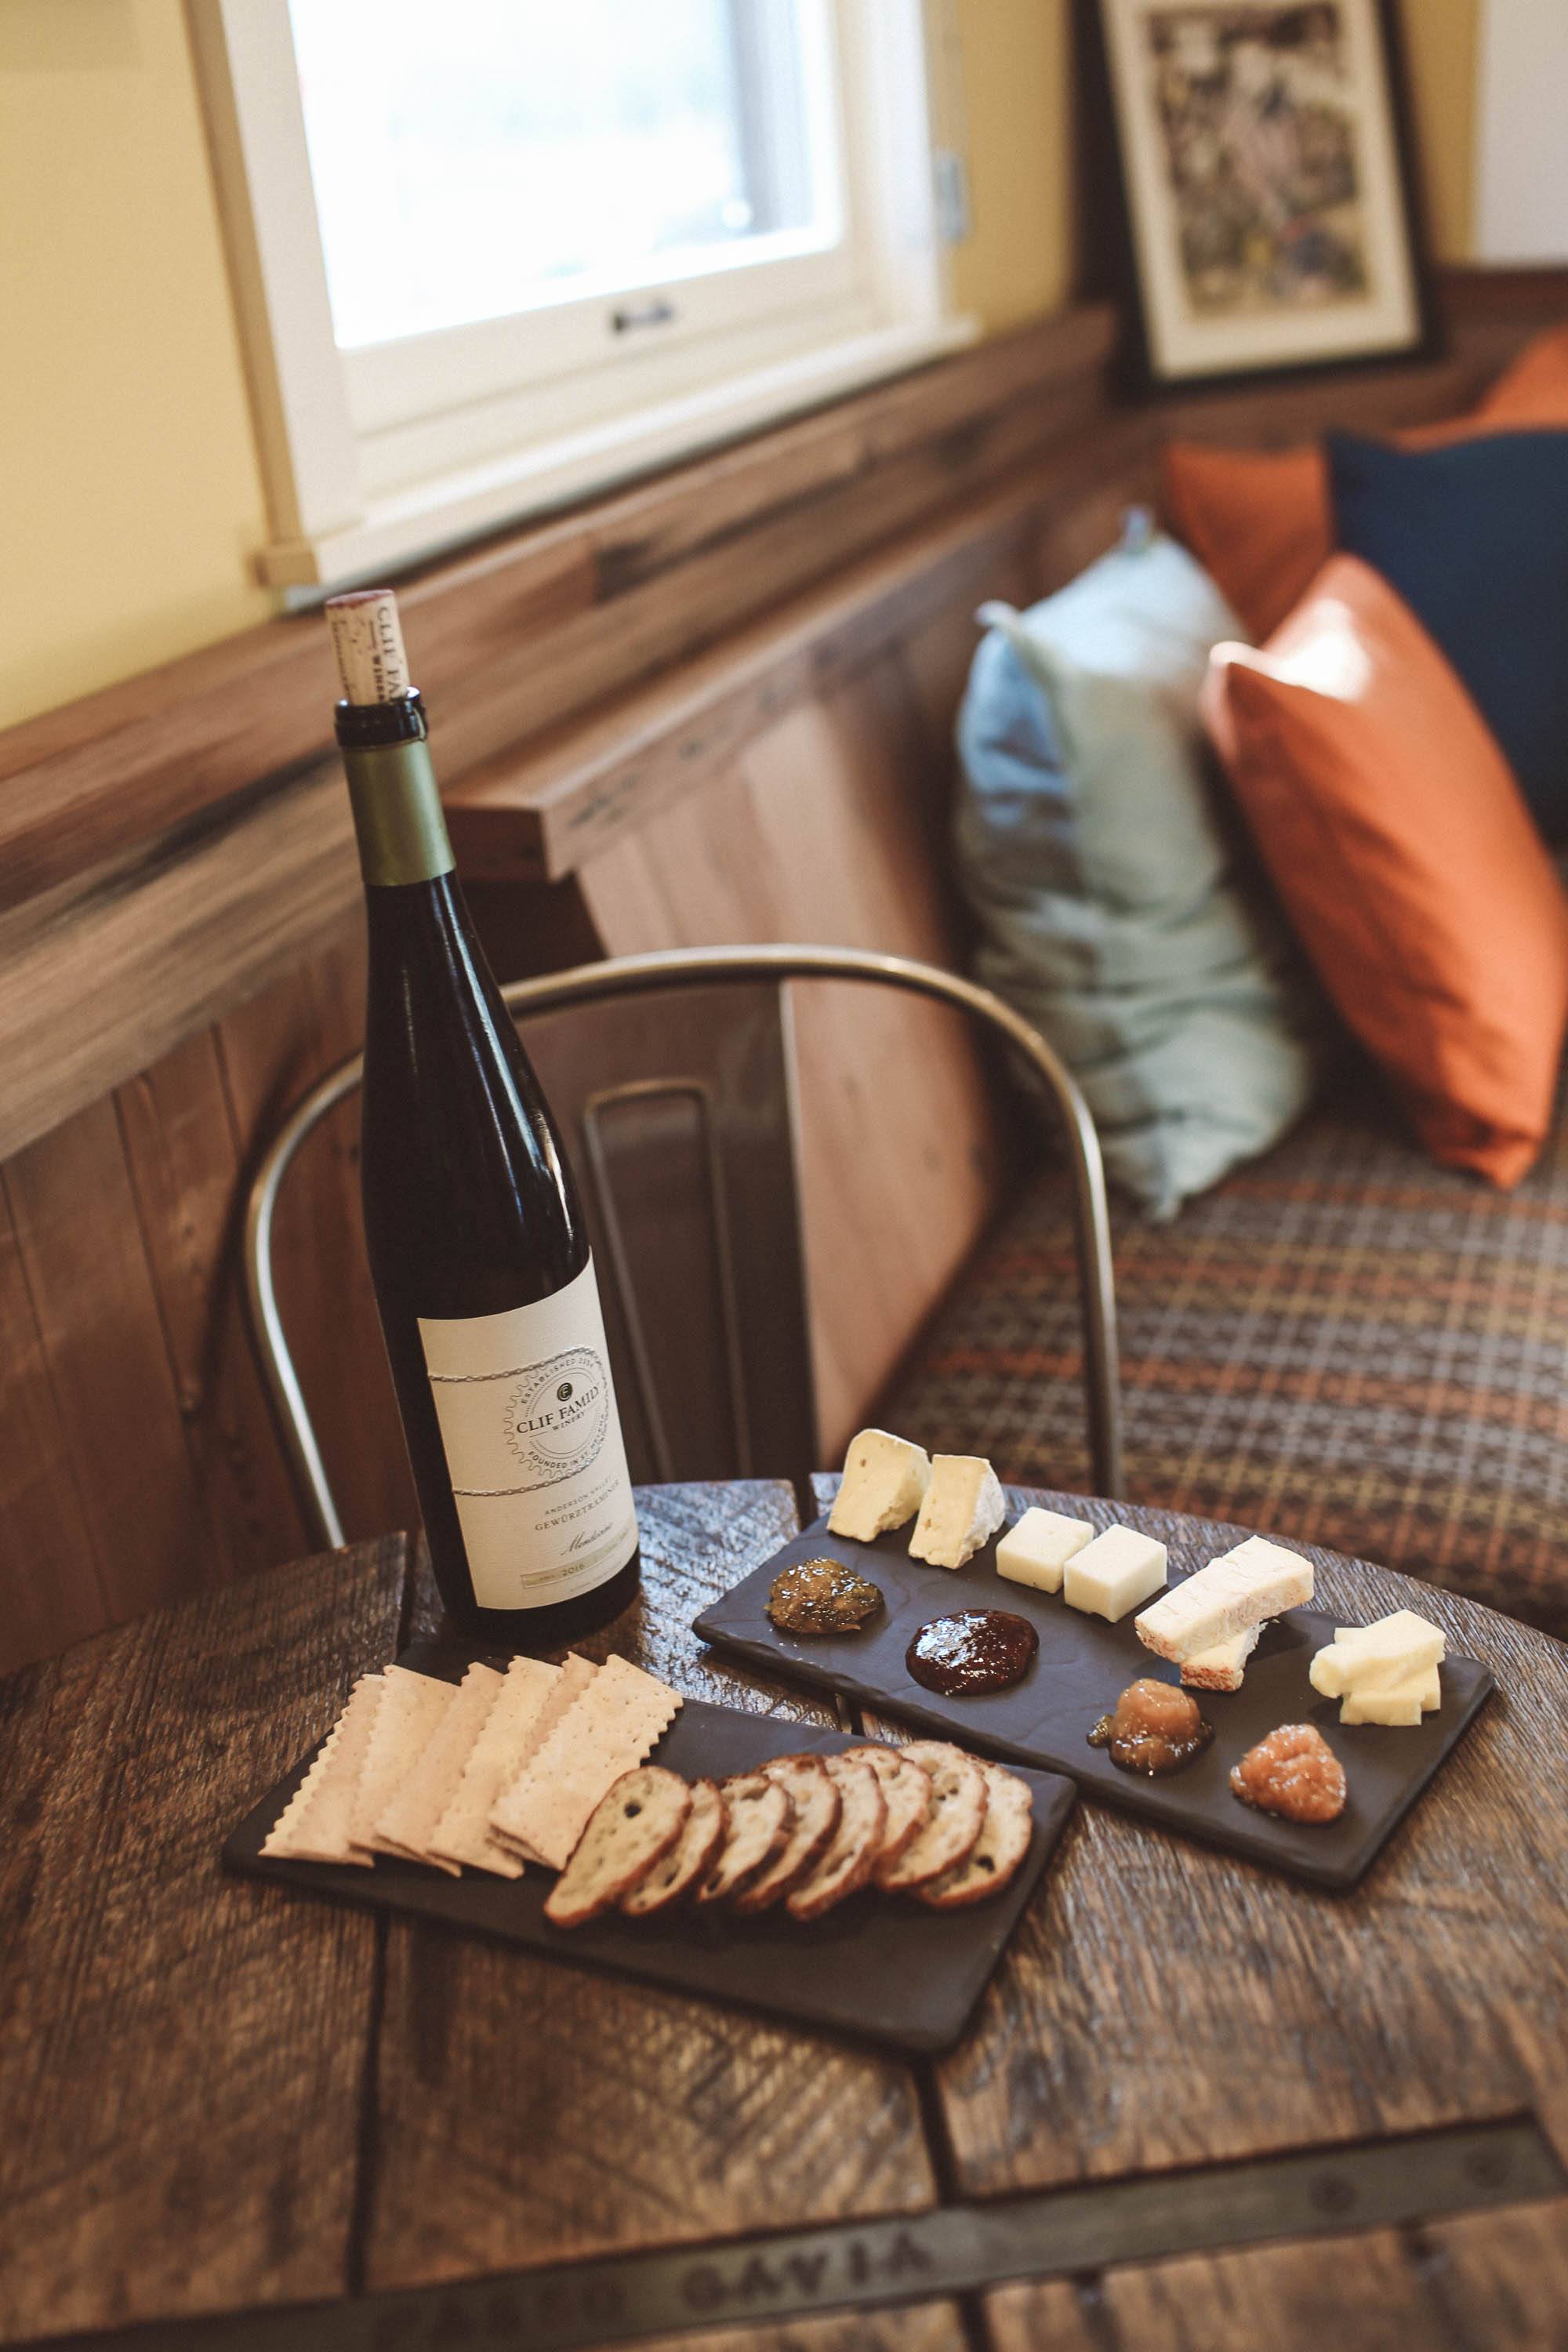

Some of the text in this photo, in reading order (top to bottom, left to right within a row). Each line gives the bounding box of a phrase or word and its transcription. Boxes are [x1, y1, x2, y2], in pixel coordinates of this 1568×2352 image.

[516, 1413, 554, 1434] CLIF
[528, 1450, 568, 1468] FOUNDED
[681, 2230, 935, 2313] GAVIA
